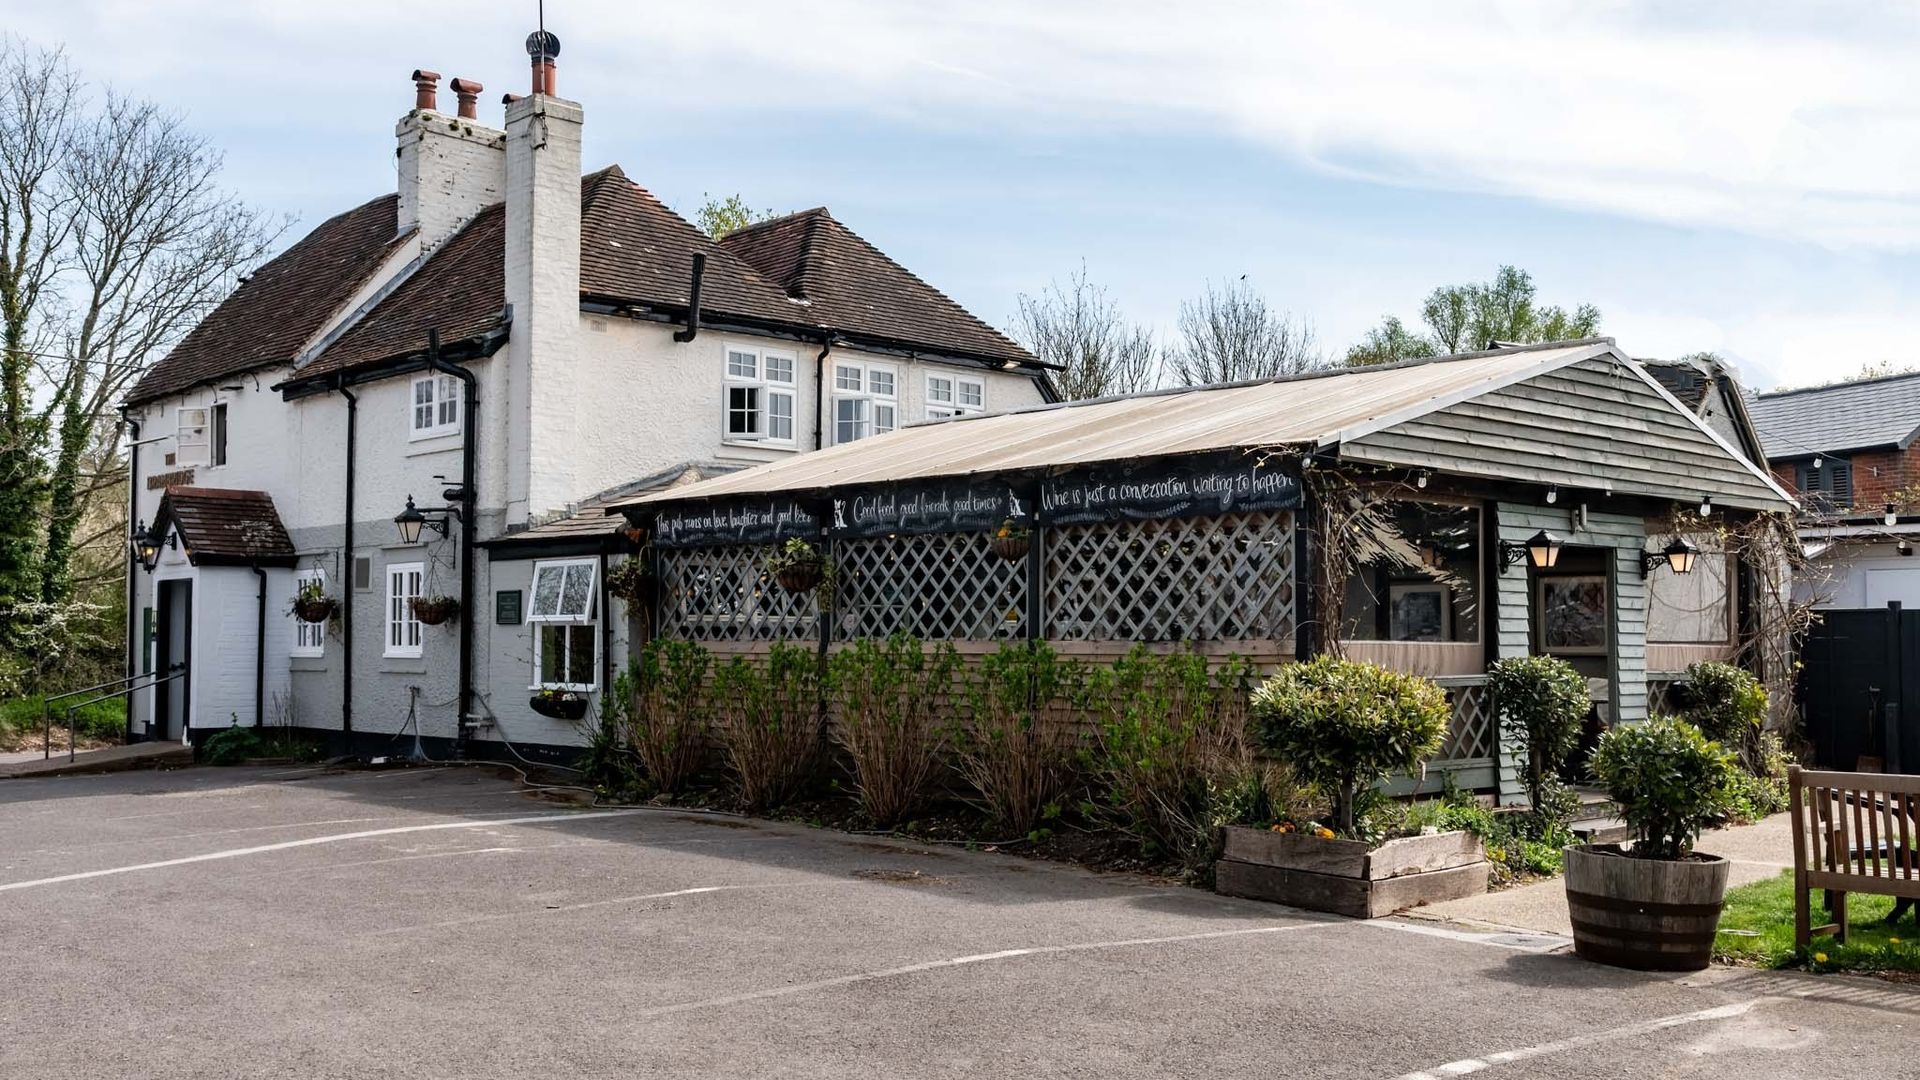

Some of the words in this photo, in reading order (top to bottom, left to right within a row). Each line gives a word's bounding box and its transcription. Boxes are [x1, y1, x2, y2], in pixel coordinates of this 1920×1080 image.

[853, 496, 877, 523] Good
[952, 490, 972, 522] good
[1041, 483, 1069, 511] Wine
[1072, 489, 1081, 504] is
[1109, 487, 1117, 500] a
[1120, 477, 1189, 500] conversation
[1193, 473, 1233, 504] waiting
[1236, 473, 1250, 492] to
[1253, 467, 1295, 494] happen
[655, 512, 669, 535] This
[672, 512, 684, 543] pub
[685, 516, 702, 529] runs
[703, 517, 713, 528] on
[729, 507, 758, 536] laughter
[761, 502, 774, 525] and
[775, 503, 792, 534] good
